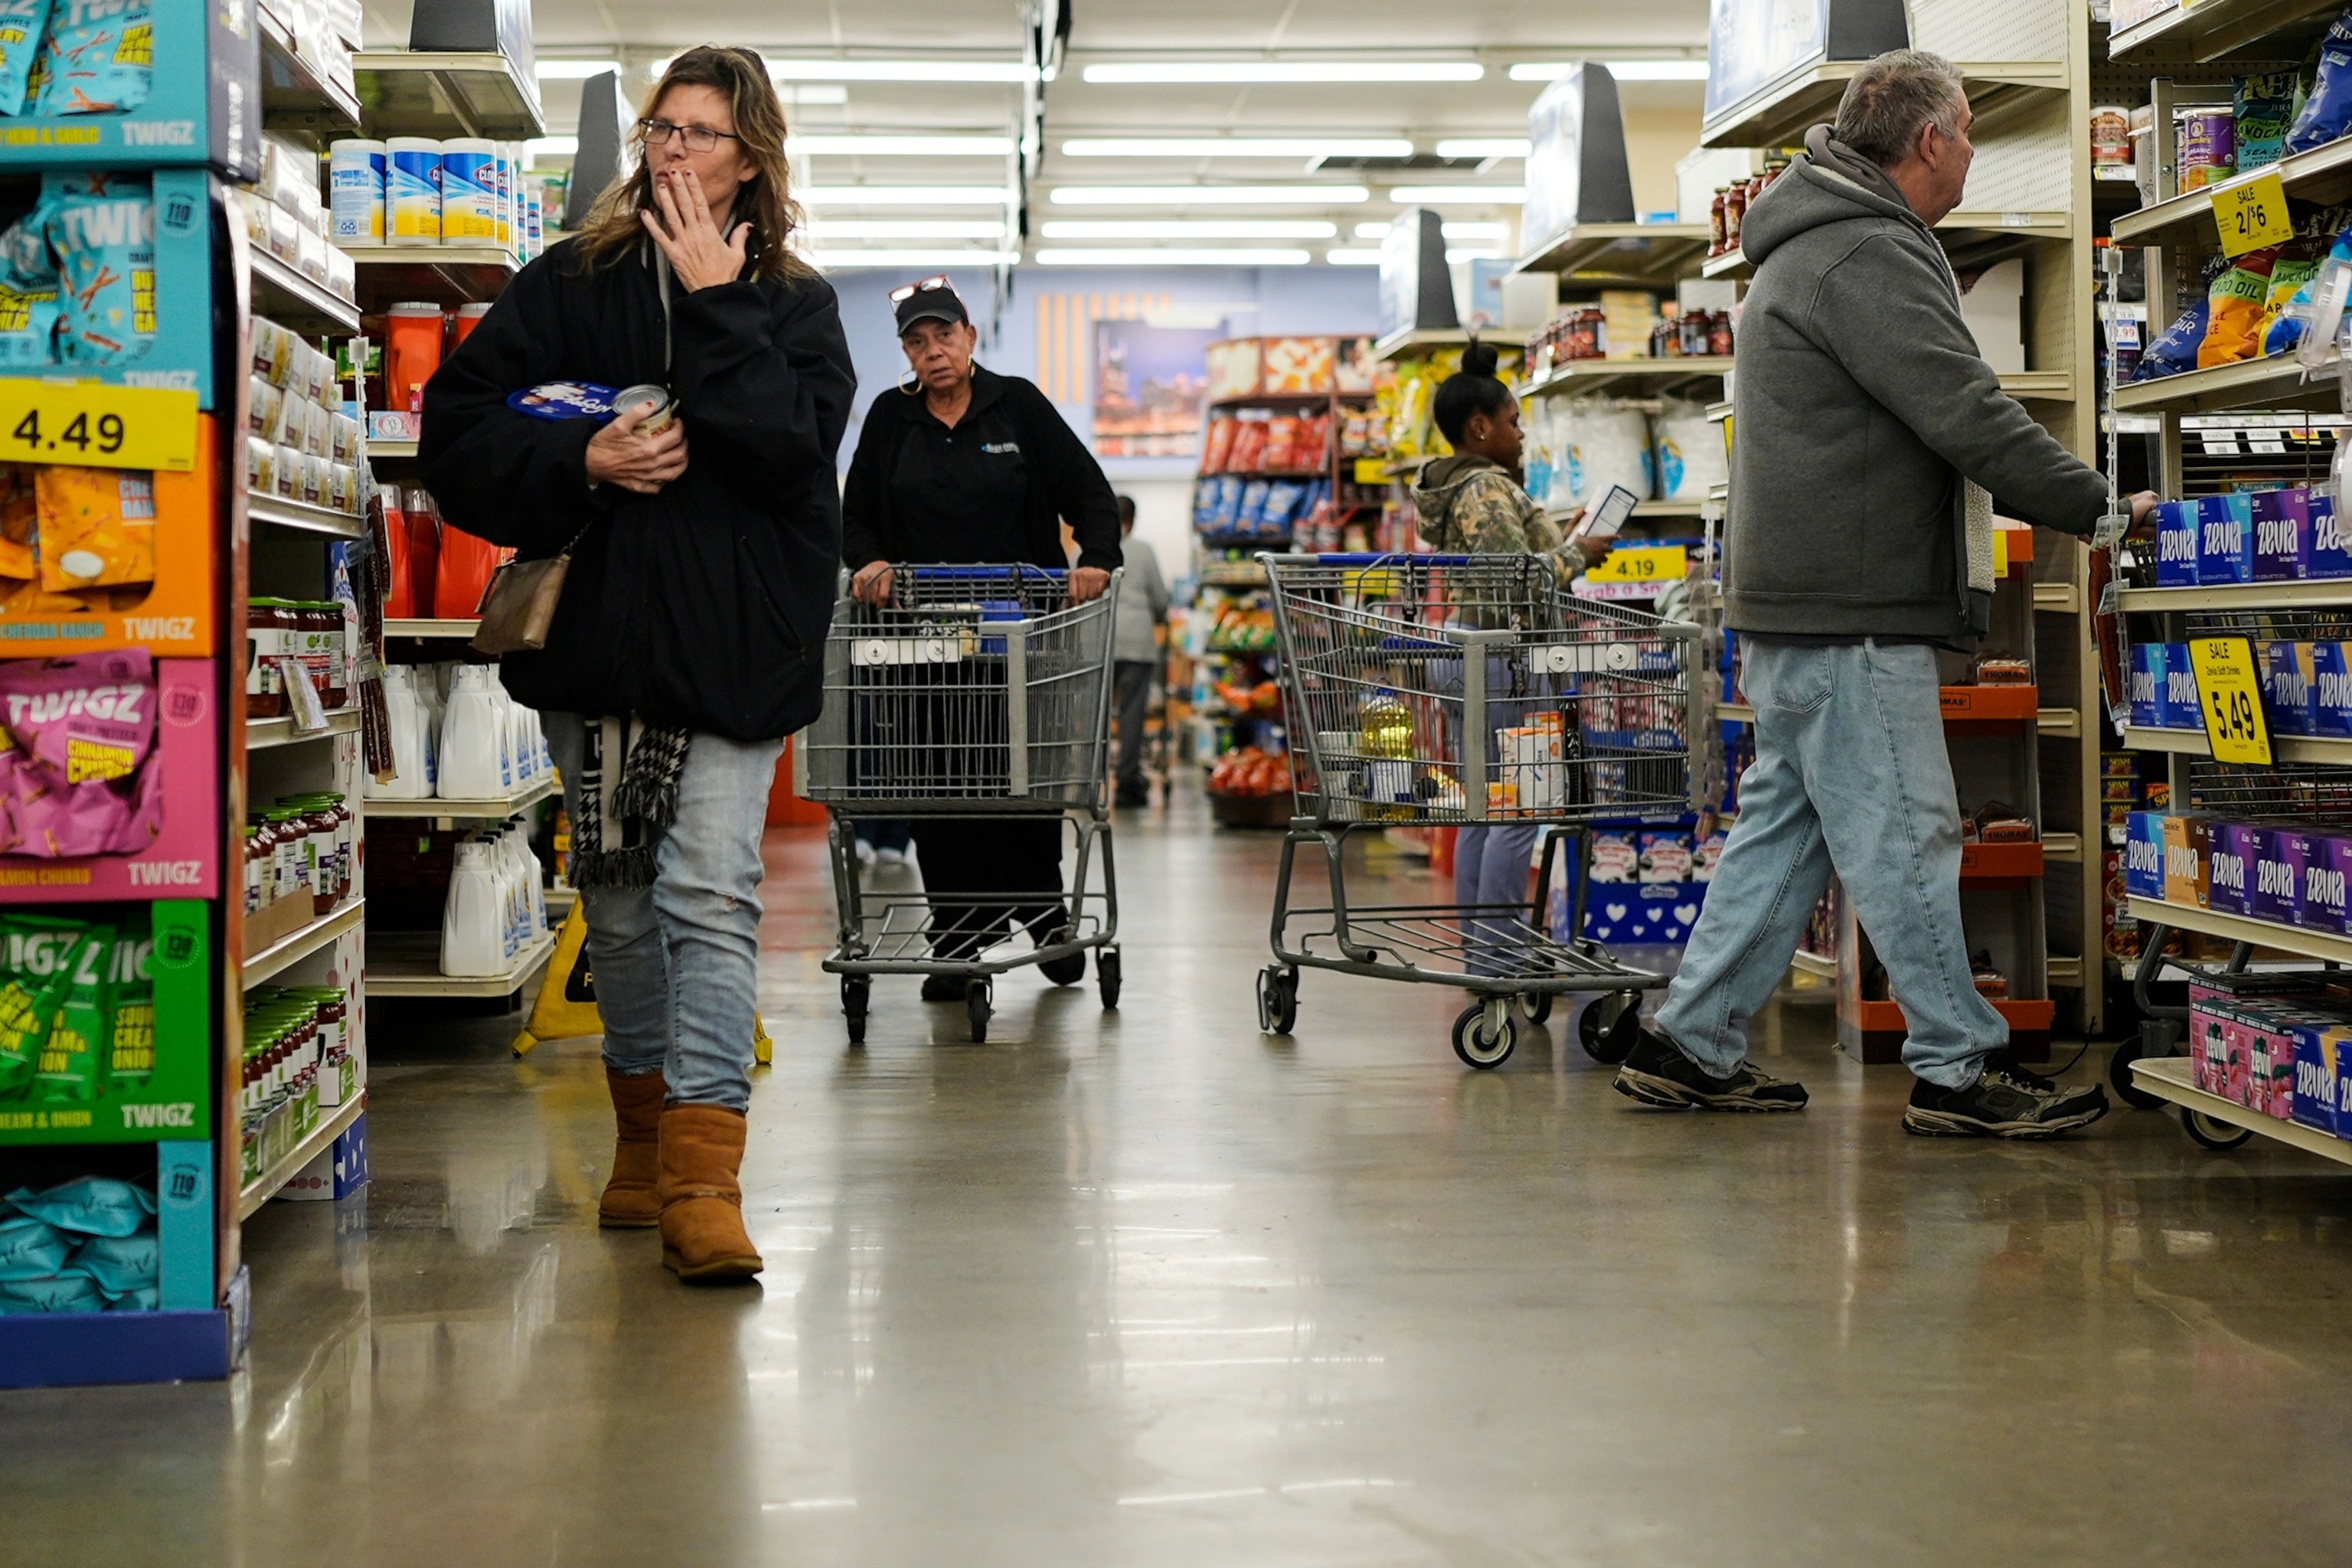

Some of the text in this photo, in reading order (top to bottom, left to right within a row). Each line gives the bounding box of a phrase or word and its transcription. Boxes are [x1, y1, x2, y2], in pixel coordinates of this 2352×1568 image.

[122, 122, 194, 145] TWIGZ
[2244, 148, 2268, 156] SEA
[2237, 187, 2255, 204] SALE
[2235, 281, 2258, 299] OIL
[12, 408, 124, 454] 4.49
[1616, 560, 1655, 577] 4.19
[123, 617, 195, 640] TWIGZ
[2210, 642, 2230, 658] SALE
[7, 684, 145, 727] TWIGZ
[2211, 691, 2256, 741] 5.49
[2109, 756, 2131, 765] SPAM
[127, 860, 202, 886] TWIGZ
[121, 1102, 195, 1128] TWIGZ
